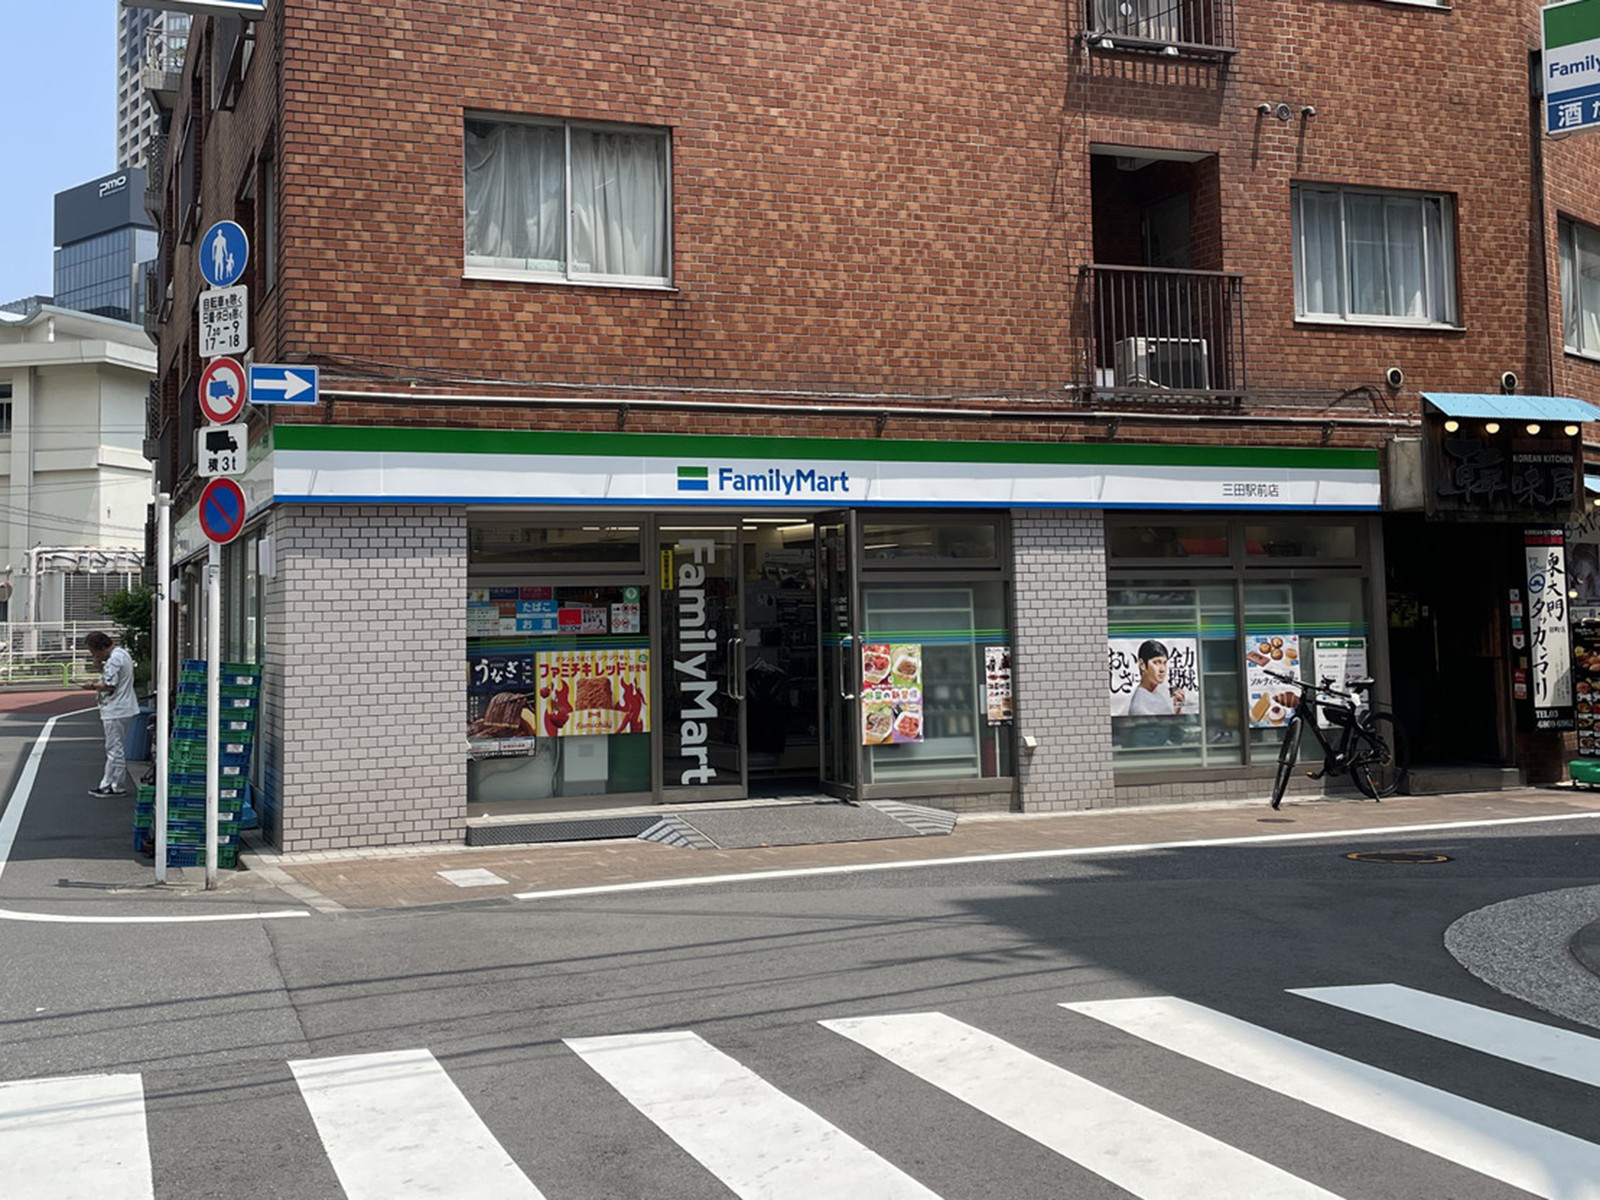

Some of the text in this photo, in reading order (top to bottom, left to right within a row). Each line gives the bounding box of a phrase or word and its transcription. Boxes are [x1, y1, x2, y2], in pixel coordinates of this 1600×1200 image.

[1512, 455, 1574, 463] KOREAN KITCHEN
[718, 468, 849, 495] FamilyMart
[1222, 483, 1279, 497] 三田駅前店
[1545, 552, 1564, 622] 東大門
[522, 602, 552, 612] たばこ
[474, 659, 519, 684] うなぎ
[673, 538, 718, 785] FamilyMart
